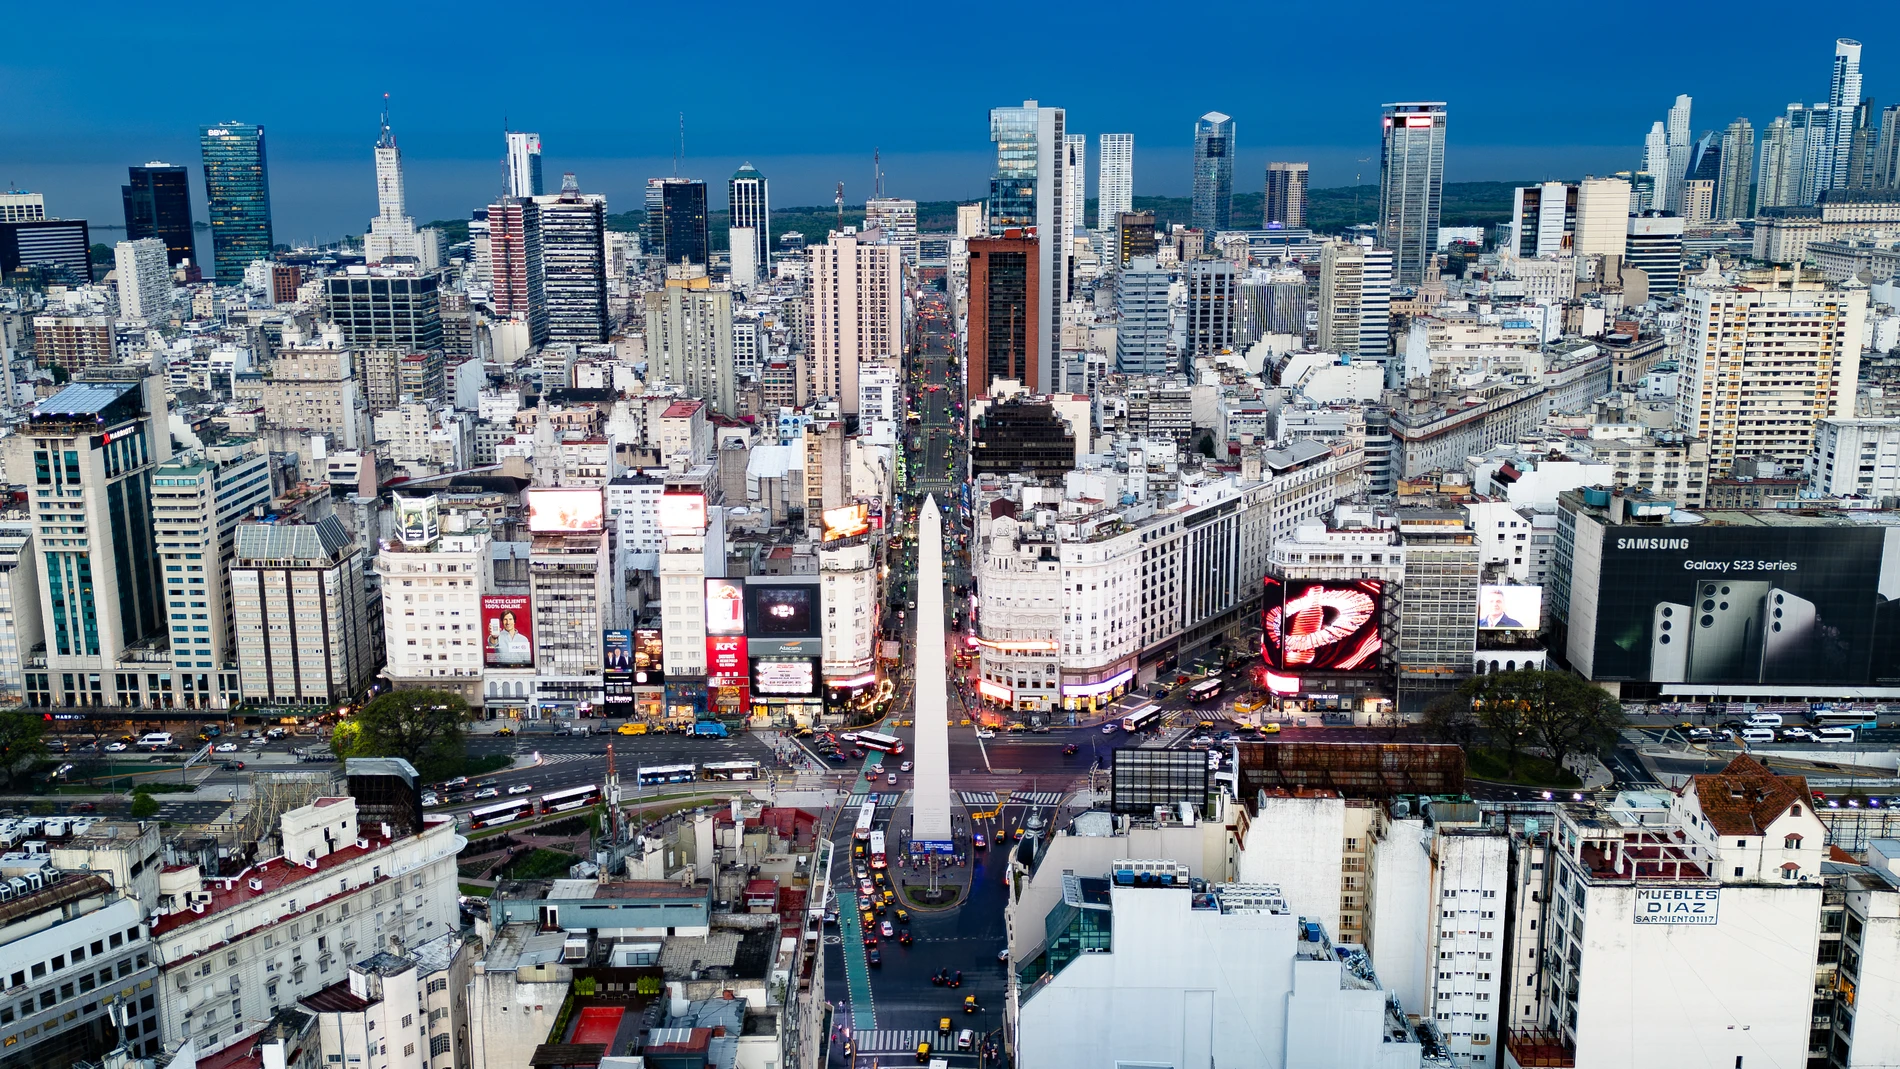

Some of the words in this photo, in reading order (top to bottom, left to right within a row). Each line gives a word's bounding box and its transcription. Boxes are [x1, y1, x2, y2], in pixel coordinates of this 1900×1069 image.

[109, 426, 135, 440] MARRIOTT
[1617, 538, 1690, 550] SAMSUNG
[1684, 560, 1730, 573] Galaxy
[1733, 560, 1754, 570] S23
[1757, 560, 1798, 571] Series
[716, 642, 738, 651] KFC
[1638, 890, 1717, 900] MUEBLES
[1647, 902, 1706, 913] DIAZ
